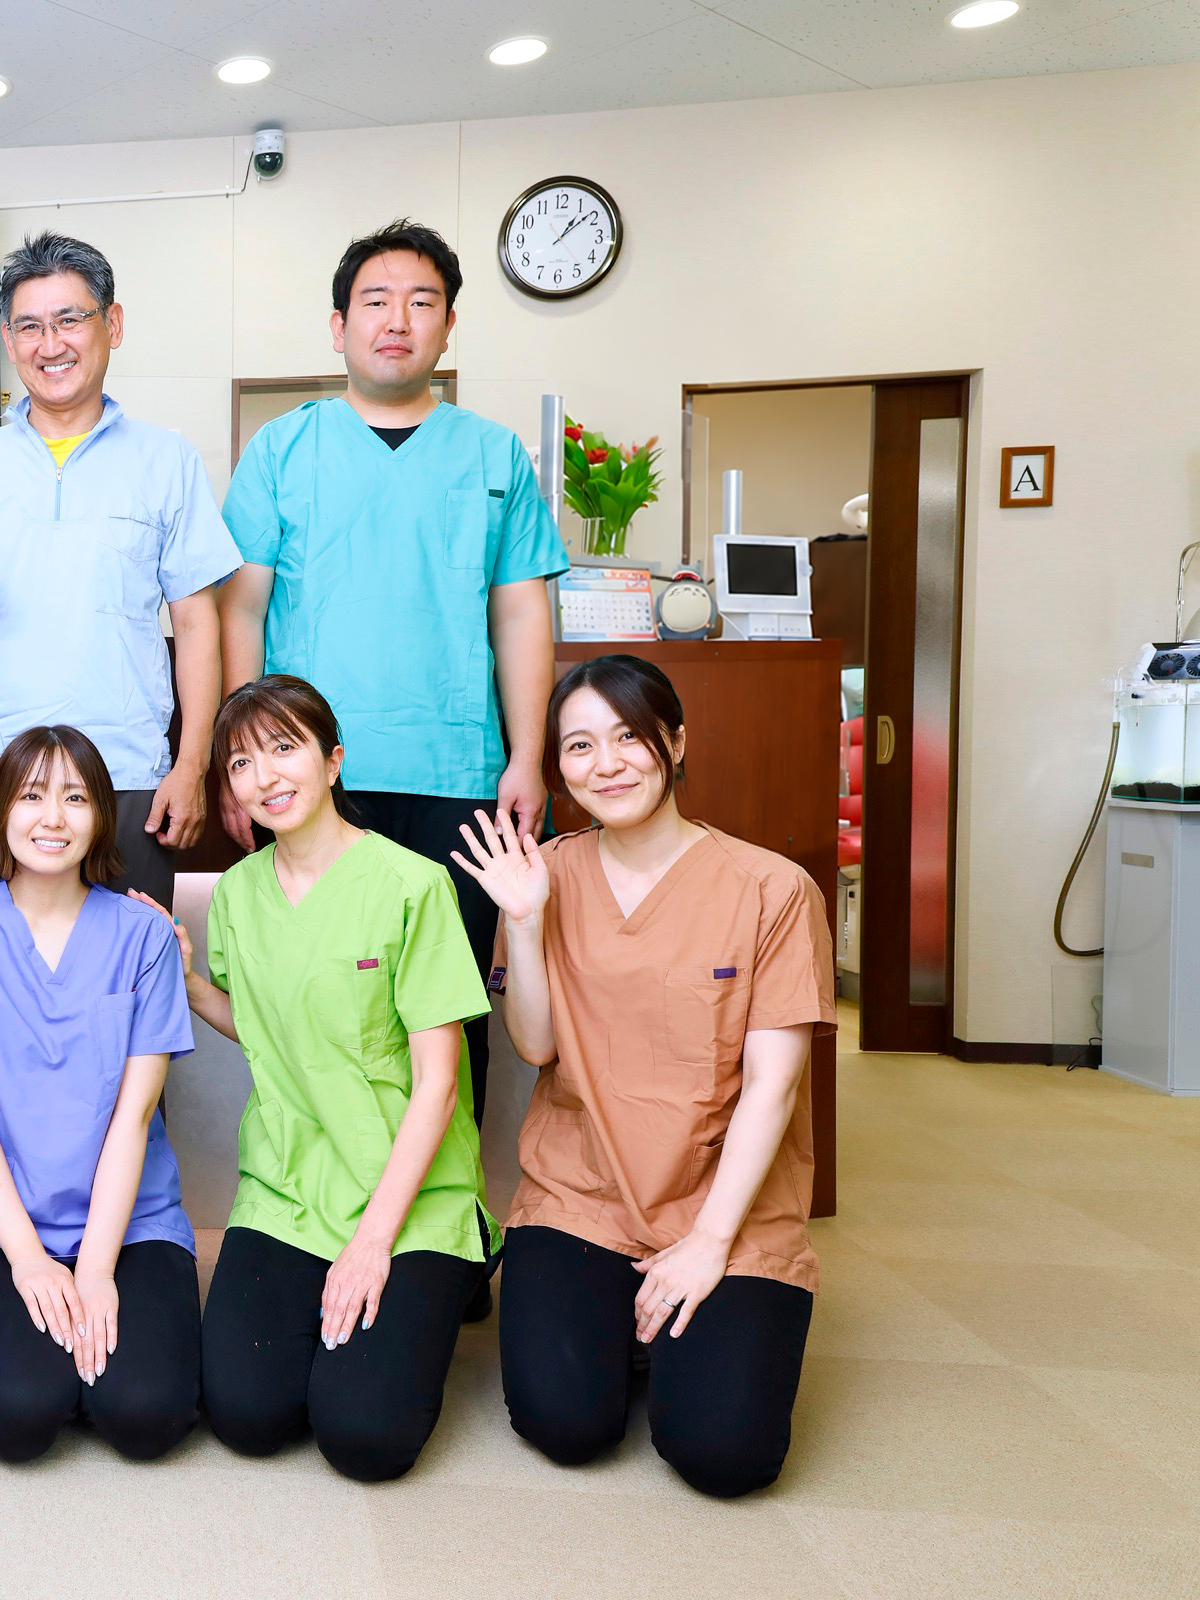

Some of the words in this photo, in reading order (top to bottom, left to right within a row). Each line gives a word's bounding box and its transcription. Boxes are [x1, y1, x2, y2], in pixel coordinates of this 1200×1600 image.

[537, 200, 548, 215] 11
[555, 194, 569, 209] 12
[578, 198, 583, 213] 1
[521, 214, 535, 230] 10
[590, 210, 599, 226] 2
[516, 234, 525, 249] 9
[594, 229, 604, 244] 3
[521, 252, 531, 267] 8
[587, 249, 596, 264] 4
[536, 265, 545, 280] 7
[553, 269, 562, 284] 6
[572, 263, 581, 278] 5
[1011, 464, 1042, 492] A
